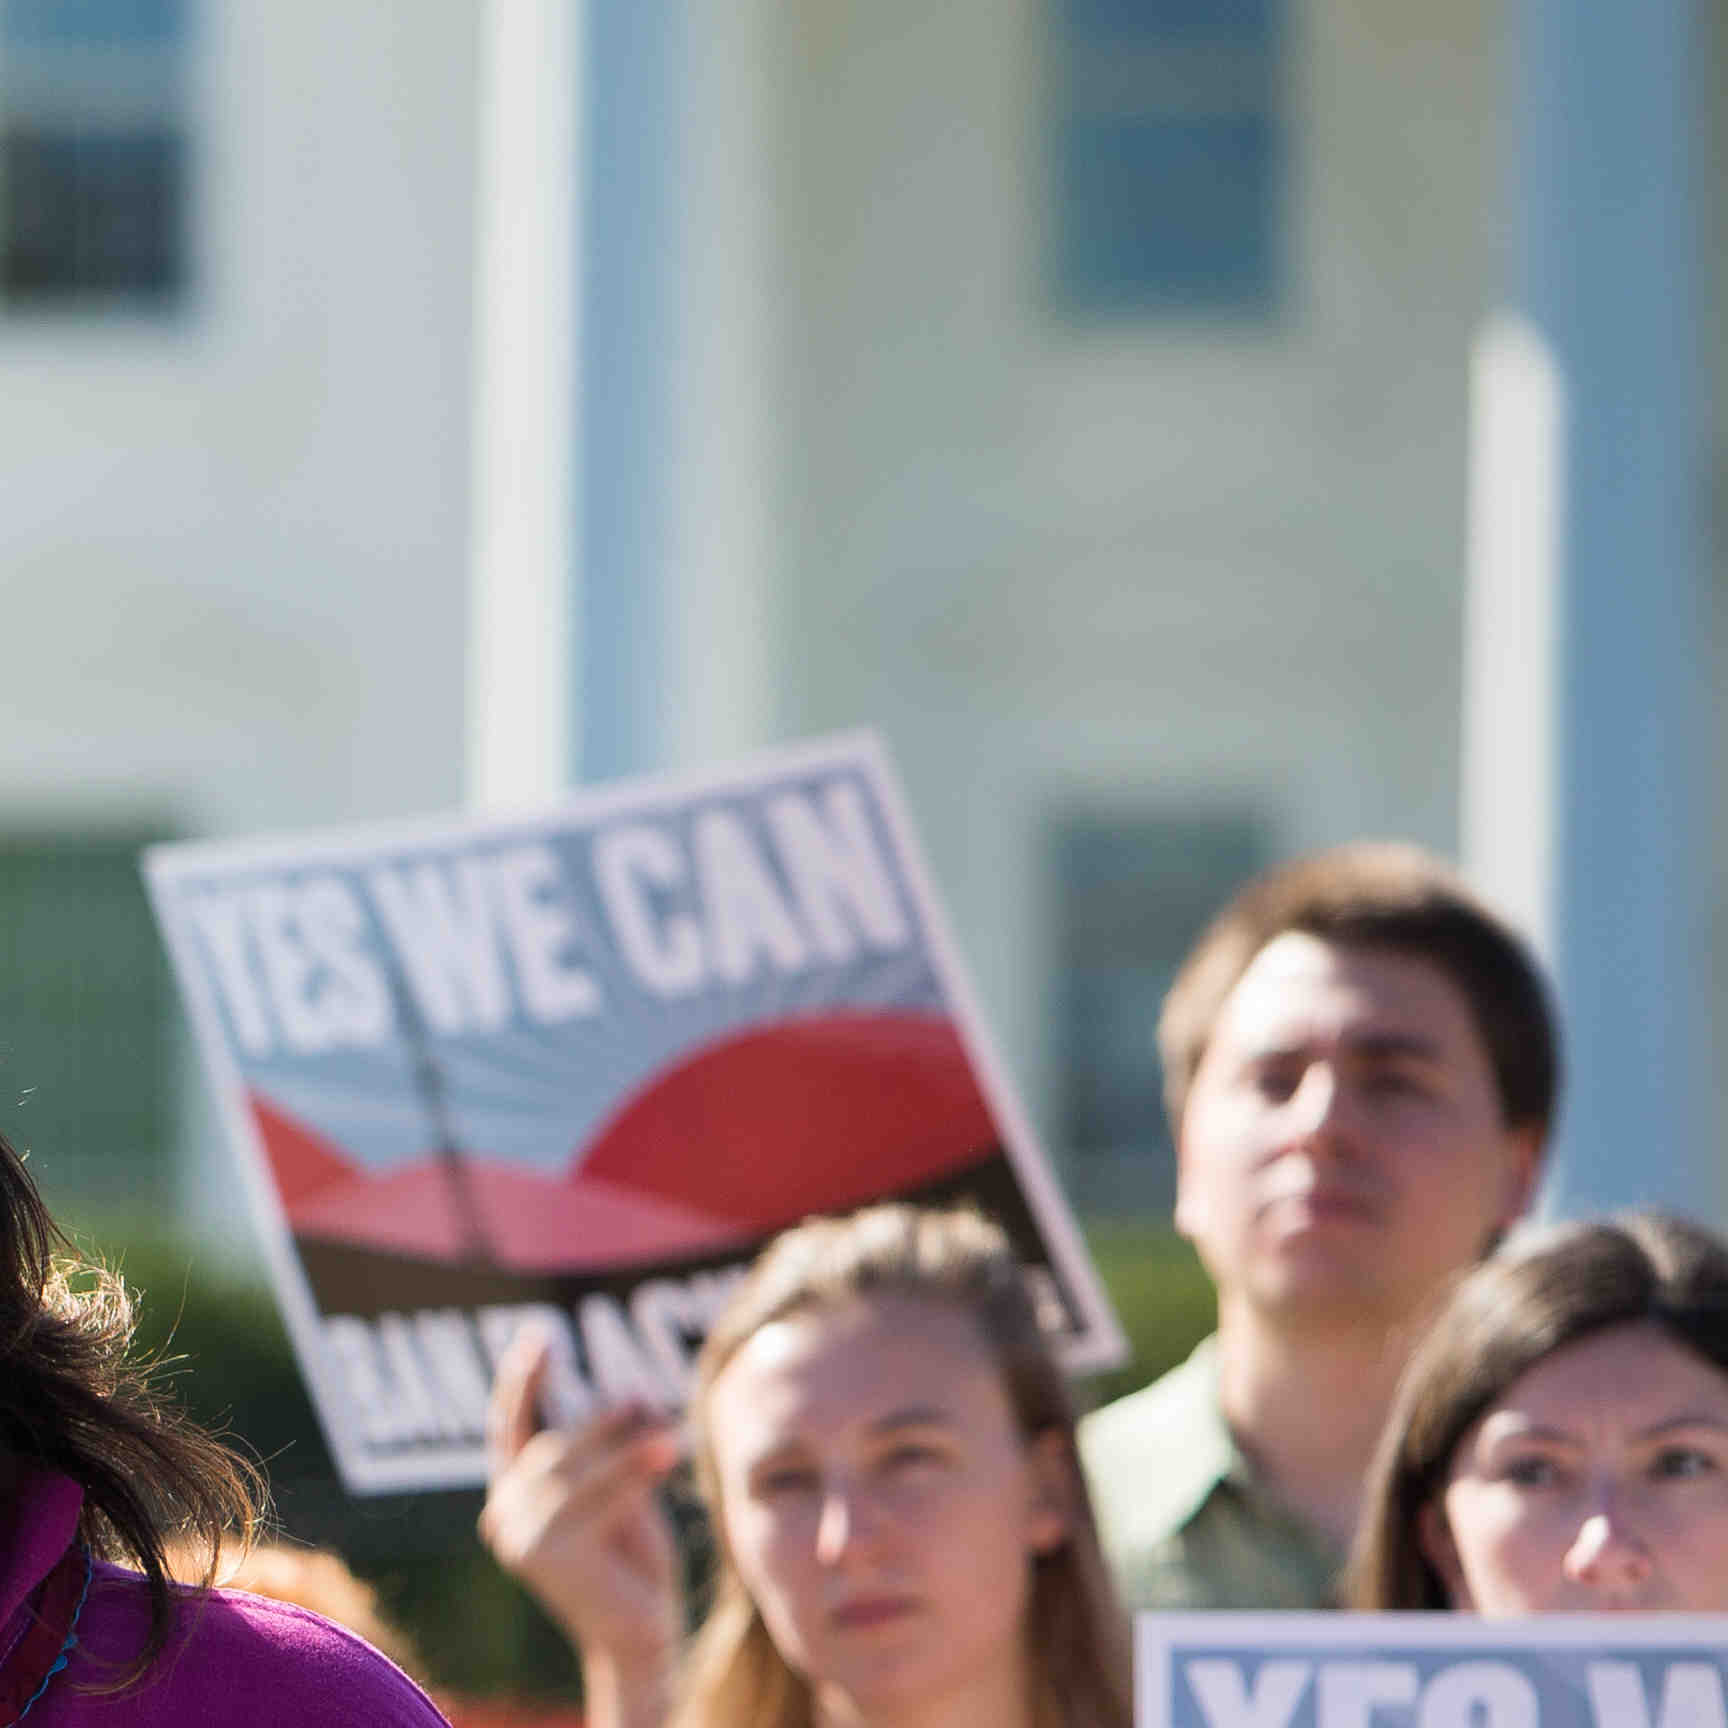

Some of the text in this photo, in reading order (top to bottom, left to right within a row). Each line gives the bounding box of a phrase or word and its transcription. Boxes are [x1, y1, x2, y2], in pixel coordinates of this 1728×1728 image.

[187, 778, 906, 1058] YES WE CAN
